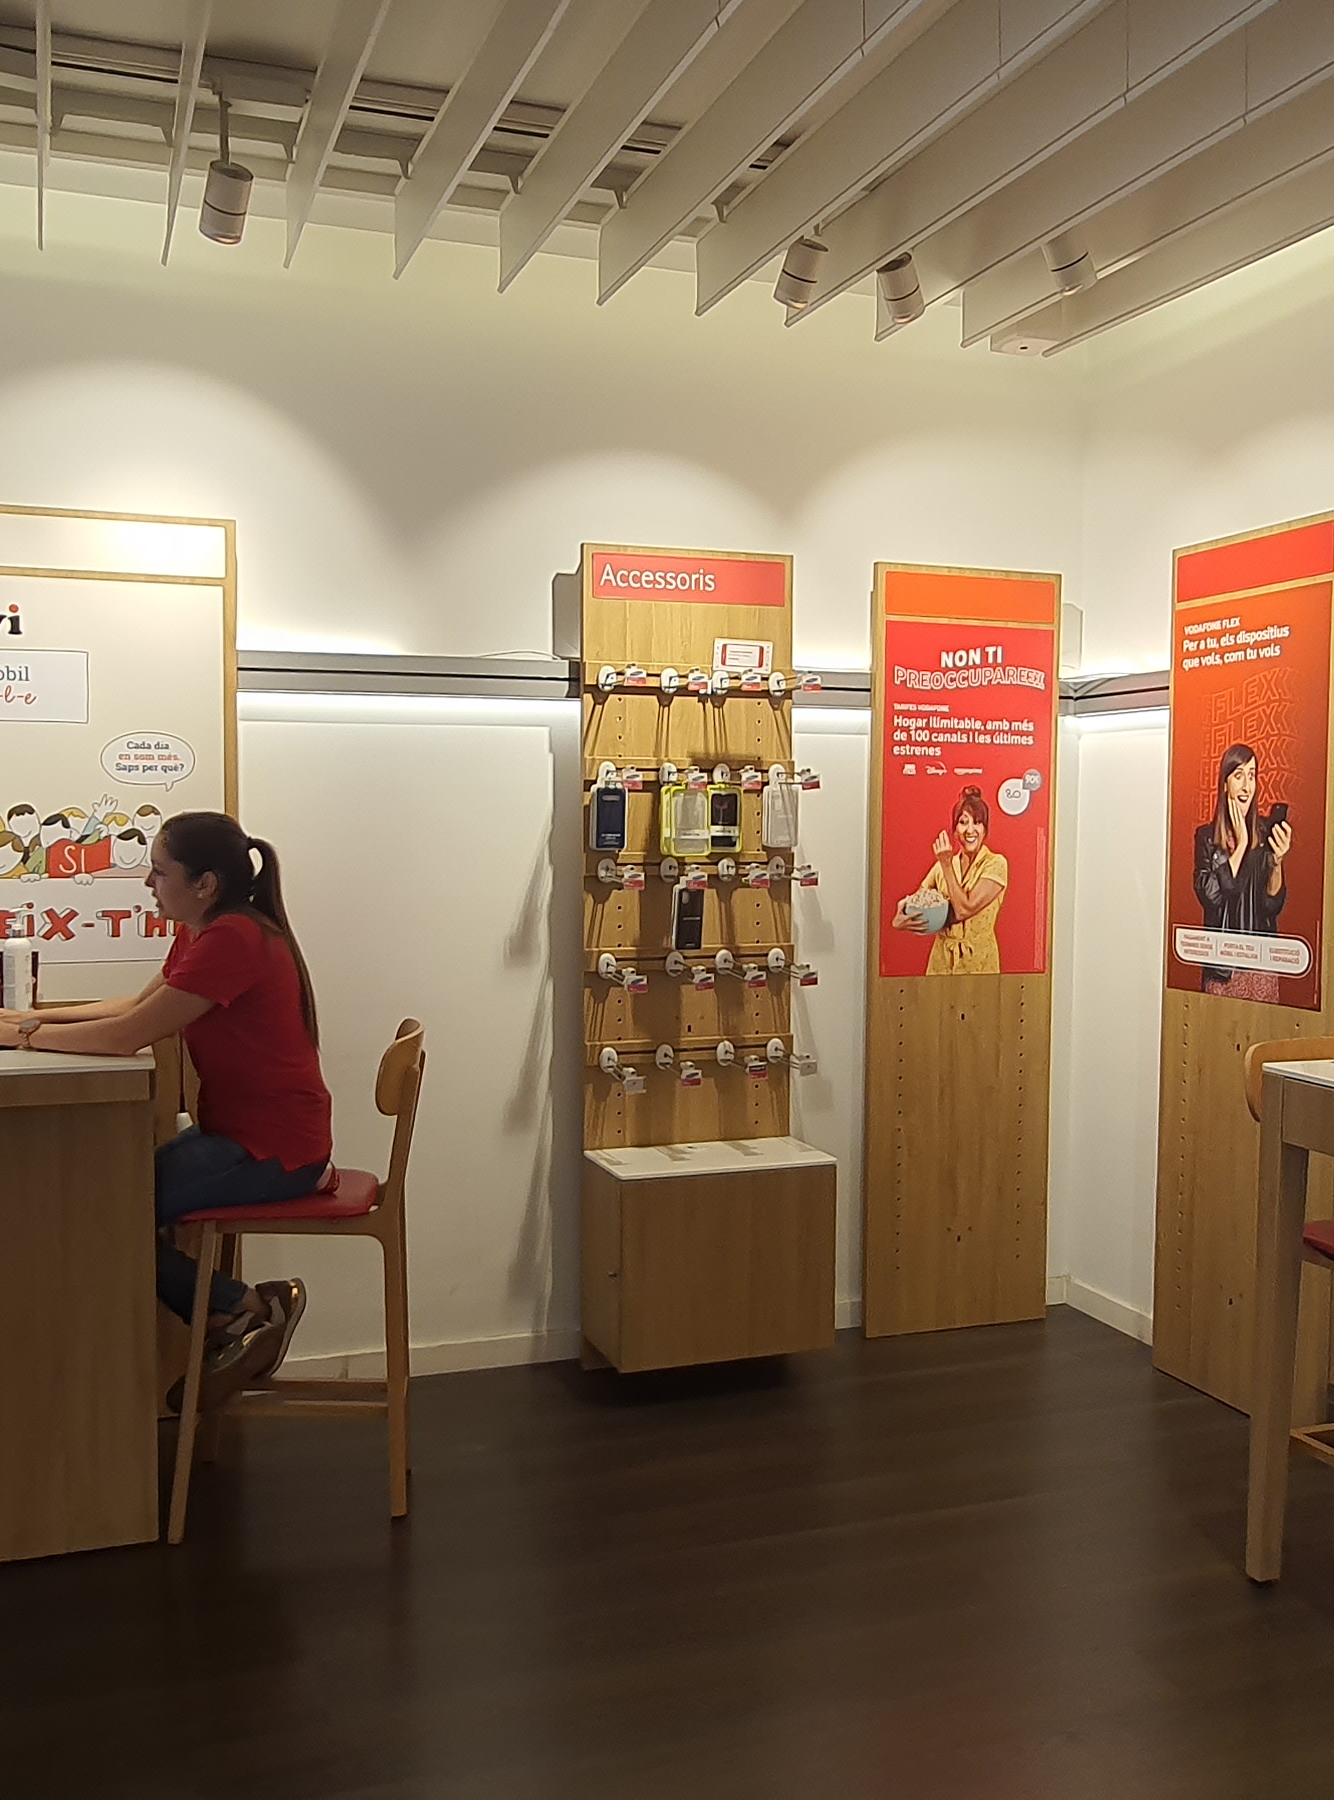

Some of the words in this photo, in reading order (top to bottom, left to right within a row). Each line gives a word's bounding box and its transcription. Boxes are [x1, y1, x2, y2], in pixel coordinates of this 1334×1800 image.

[599, 563, 715, 592] Accessoris
[1184, 620, 1222, 635] VODAFONE
[1222, 617, 1240, 629] FLEX
[1183, 639, 1199, 652] Per
[1199, 641, 1205, 650] a
[1206, 637, 1219, 649] tu,
[1220, 633, 1235, 646] els
[1236, 625, 1290, 645] dispositius
[940, 648, 981, 668] NON
[985, 646, 1002, 664] TI
[1182, 658, 1200, 672] que
[1200, 652, 1223, 666] vols,
[1223, 650, 1244, 663] com
[1246, 647, 1257, 660] tu
[1258, 643, 1281, 658] vols
[1212, 667, 1279, 723] FLEX
[893, 715, 928, 730] Hogar
[986, 719, 1010, 731] amb
[1011, 719, 1035, 732] més
[126, 741, 152, 750] Cada
[154, 741, 169, 750] dia
[893, 729, 907, 741] de
[909, 730, 930, 742] 100
[931, 731, 968, 743] canals
[969, 732, 973, 743] i
[974, 732, 991, 744] les
[993, 731, 1034, 745] últimes
[118, 753, 131, 761] en
[134, 753, 155, 761] som
[893, 744, 941, 756] estrenes
[115, 762, 139, 773] Saps
[142, 764, 158, 773] per
